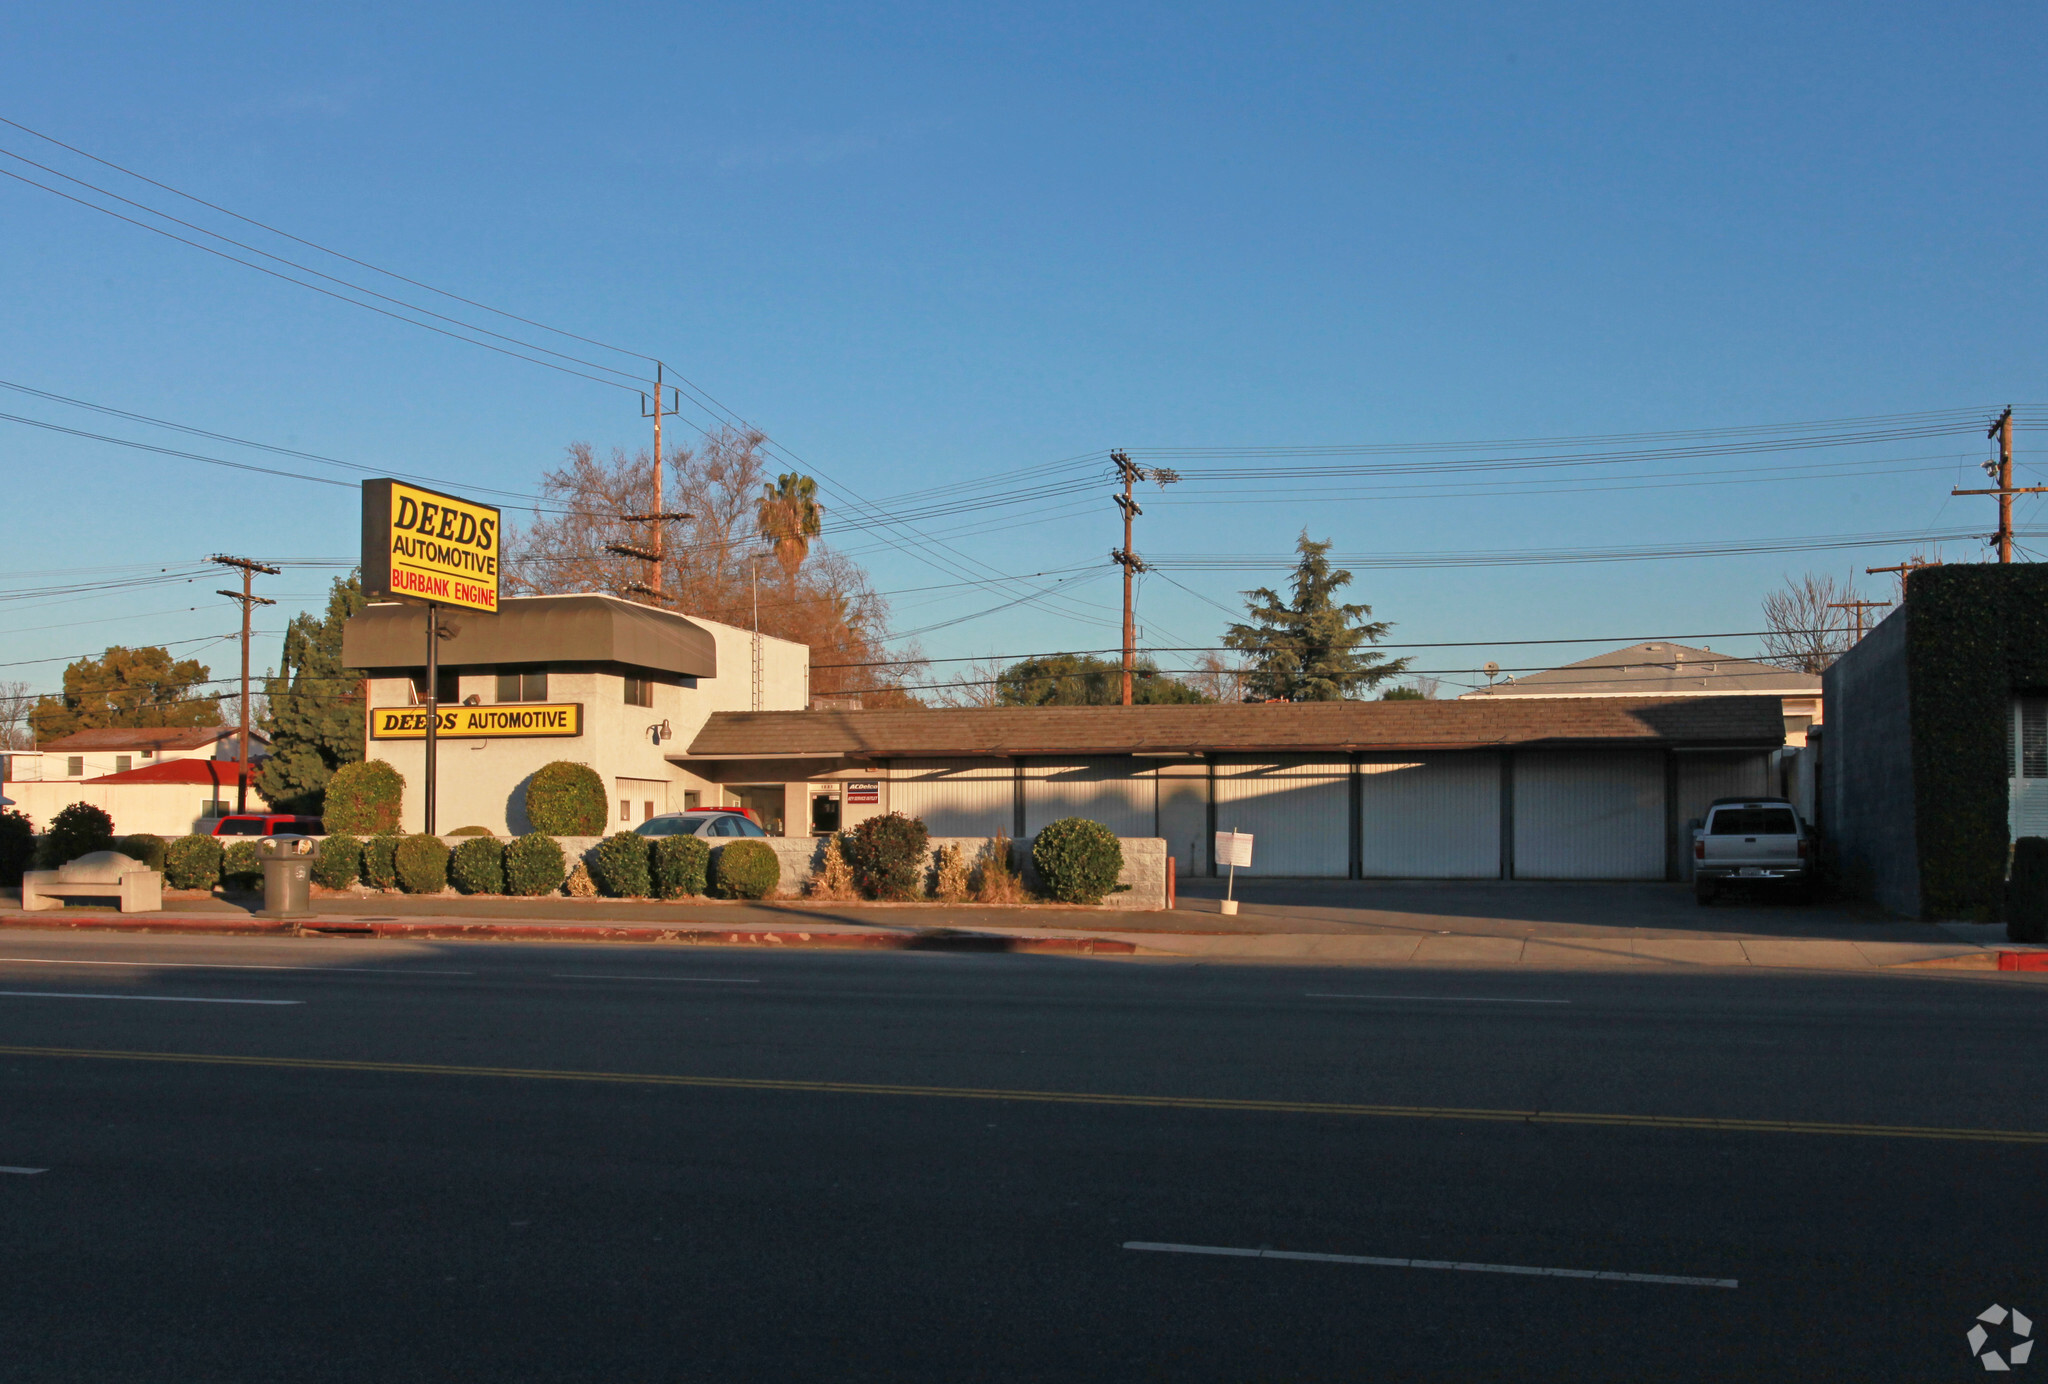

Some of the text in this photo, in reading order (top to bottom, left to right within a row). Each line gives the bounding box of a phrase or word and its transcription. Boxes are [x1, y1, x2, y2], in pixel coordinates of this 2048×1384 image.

[394, 495, 495, 550] DEEDS
[392, 535, 496, 576] AUTOMOTIVE
[392, 568, 495, 607] BURBANK ENGINE
[467, 711, 567, 729] AUTOMOTIVE
